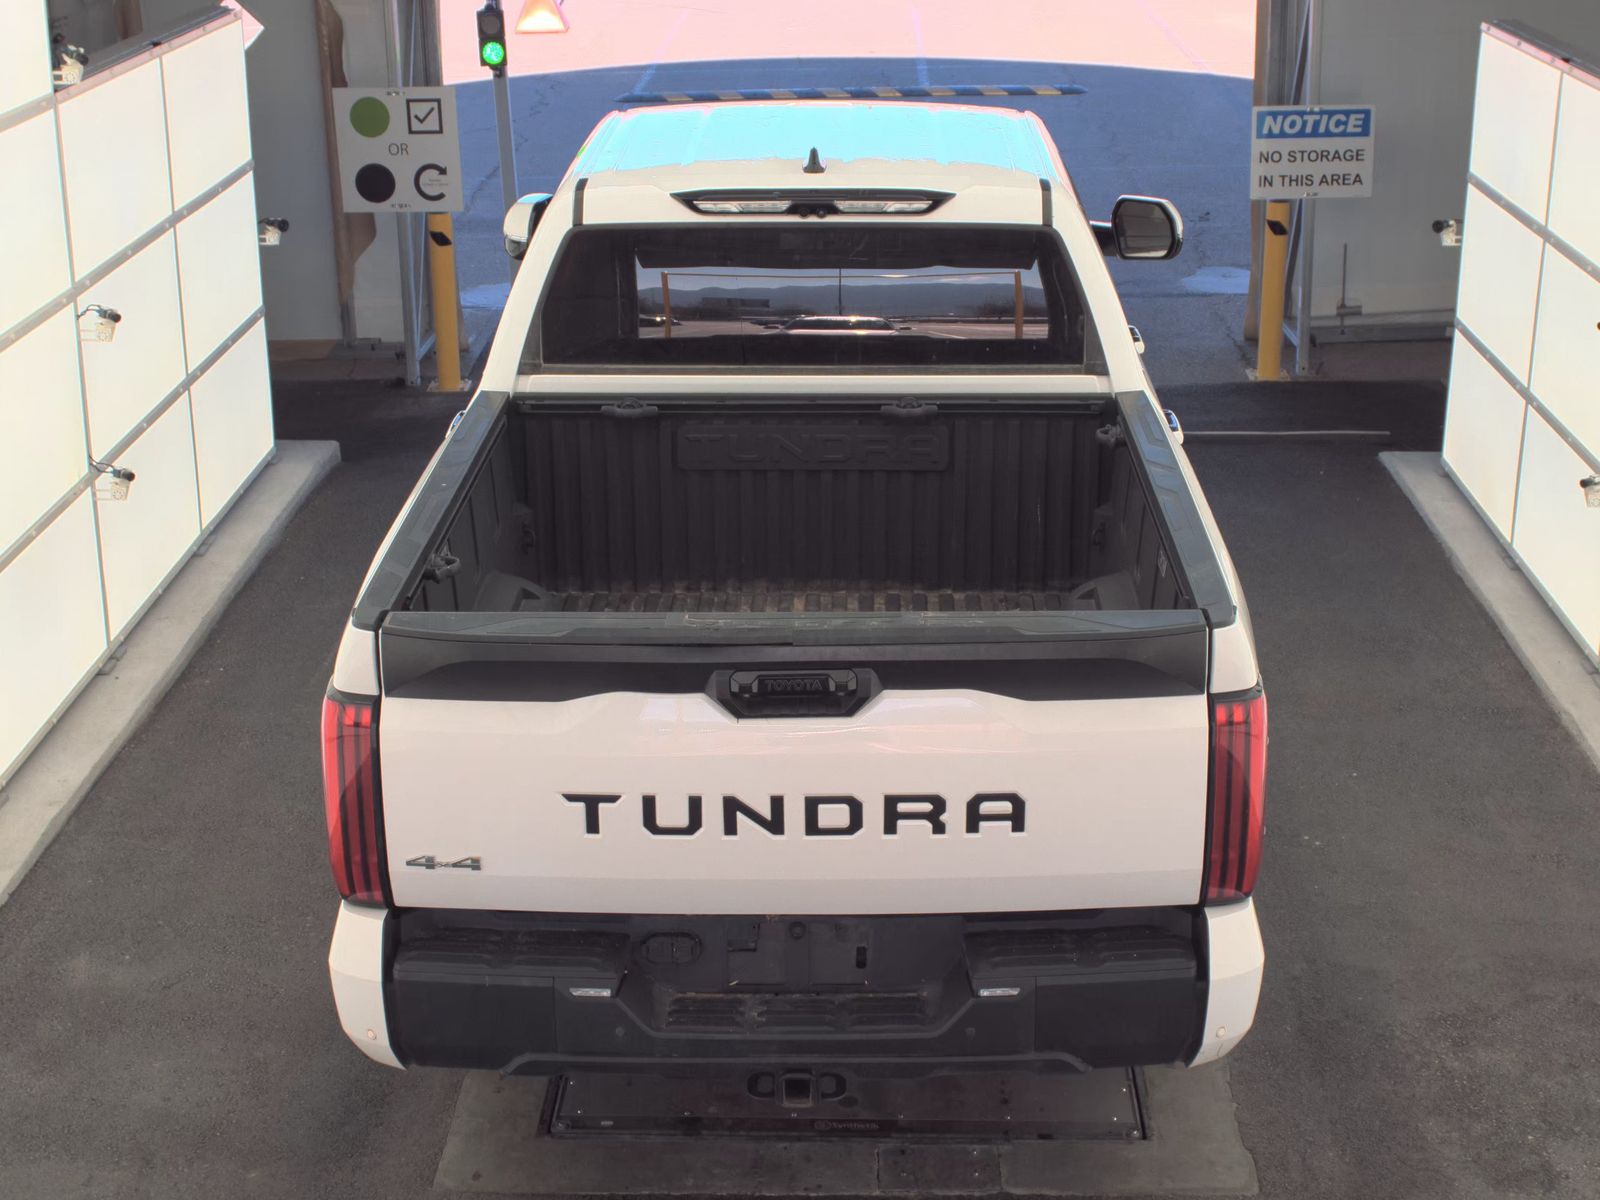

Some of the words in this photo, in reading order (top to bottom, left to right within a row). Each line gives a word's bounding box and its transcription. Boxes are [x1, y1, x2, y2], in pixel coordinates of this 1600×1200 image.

[1262, 113, 1365, 134] NOTICE
[388, 142, 409, 156] OR
[1259, 150, 1282, 163] NO
[1287, 149, 1366, 163] STORAGE
[1258, 175, 1274, 188] IN
[1278, 174, 1314, 187] THIS
[1318, 173, 1363, 187] AREA
[685, 433, 940, 463] TUNDRA
[764, 679, 823, 691] TOYOTA
[560, 792, 1027, 837] TUNDRA
